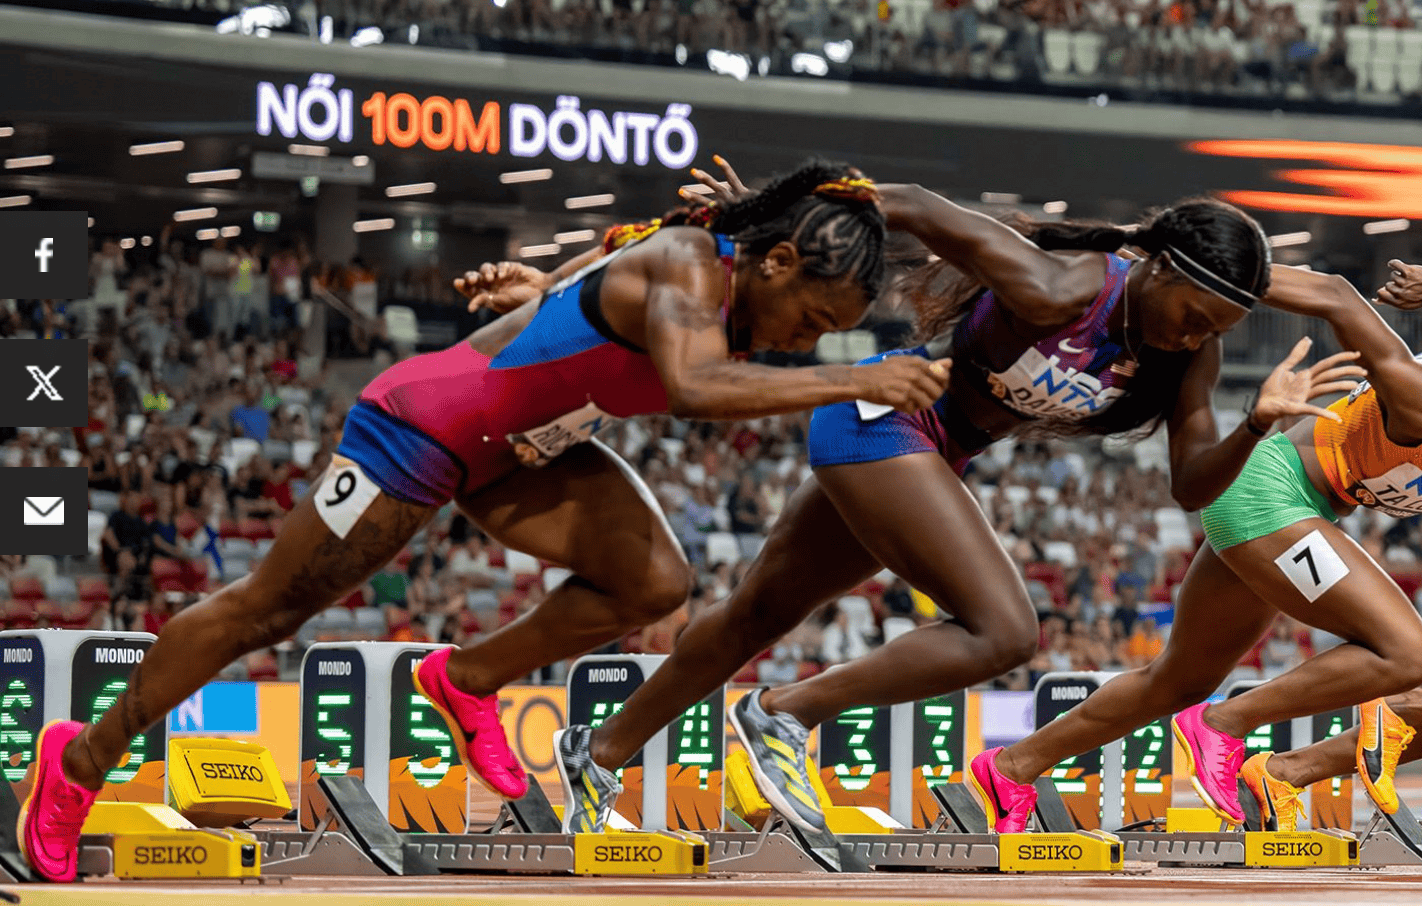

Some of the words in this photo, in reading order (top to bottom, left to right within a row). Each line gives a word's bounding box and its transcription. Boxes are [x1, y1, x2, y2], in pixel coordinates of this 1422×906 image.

[256, 73, 354, 143] NŐI
[362, 91, 501, 154] 100M
[509, 95, 698, 169] DÖNTŐ
[326, 470, 357, 507] 9
[1293, 546, 1321, 587] 7
[3, 648, 33, 663] MONDO
[95, 647, 145, 664] MONDO
[318, 661, 352, 676] MONDO
[588, 668, 628, 683] MONDO
[1051, 686, 1088, 701] MONDO
[316, 695, 352, 777] 5
[408, 695, 452, 788] 5
[678, 704, 713, 790] 4
[834, 707, 877, 791] 3
[921, 705, 953, 788] 3
[201, 762, 264, 783] SEIKO
[134, 846, 208, 865] SEIKO
[594, 845, 663, 862] SEIKO
[1018, 844, 1083, 860] SEIKO
[1263, 842, 1323, 857] SEIKO
